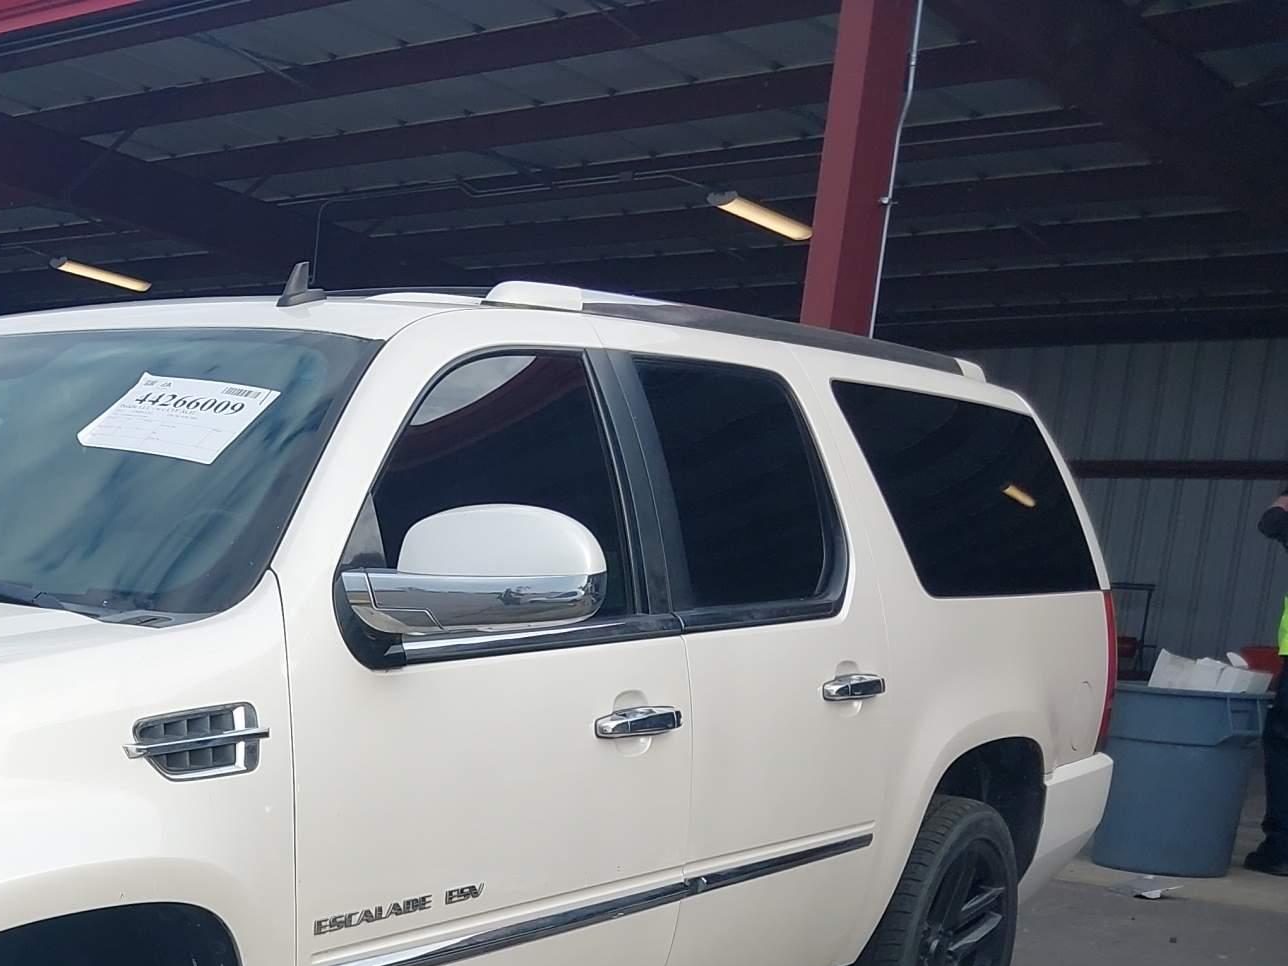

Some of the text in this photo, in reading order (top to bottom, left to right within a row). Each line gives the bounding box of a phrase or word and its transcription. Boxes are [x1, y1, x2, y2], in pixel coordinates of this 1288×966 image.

[135, 392, 246, 416] 44266009
[313, 882, 485, 936] ESCALADE ESV
